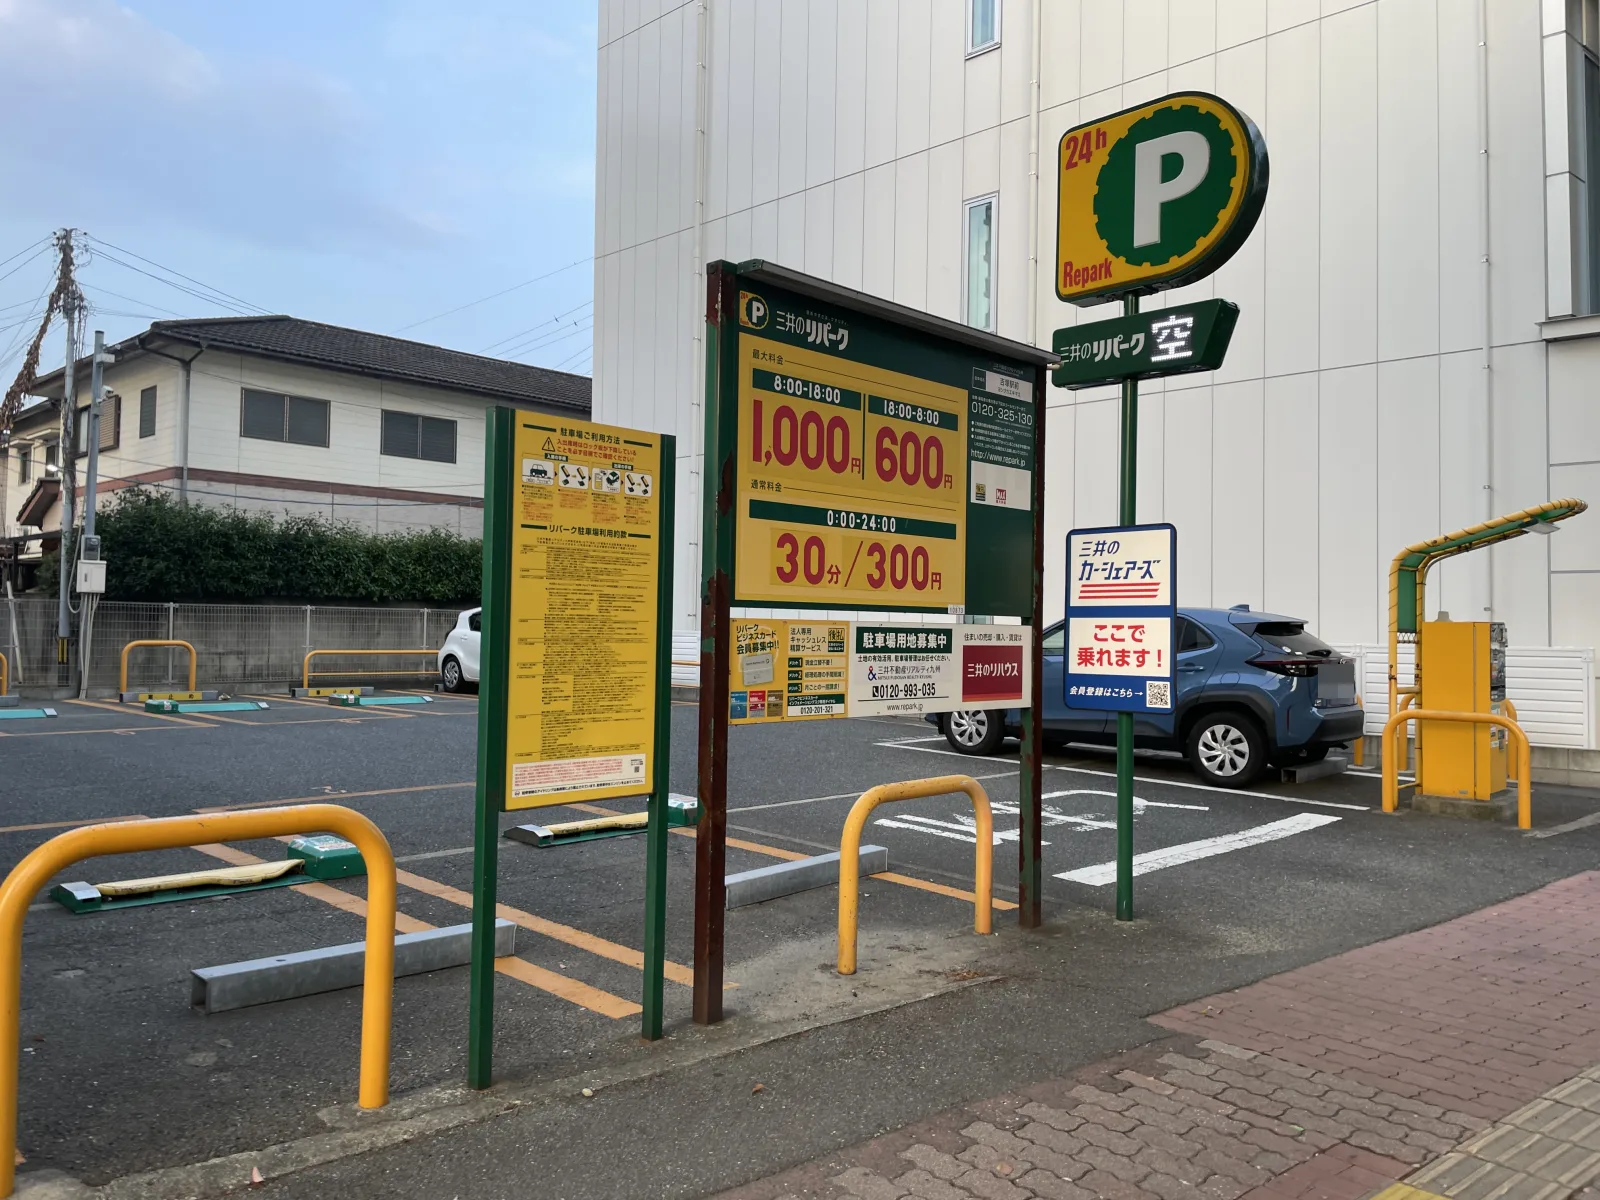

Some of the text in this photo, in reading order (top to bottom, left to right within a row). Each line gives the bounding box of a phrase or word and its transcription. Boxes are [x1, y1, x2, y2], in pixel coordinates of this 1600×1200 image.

[1065, 128, 1107, 170] 24h
[1134, 131, 1210, 248] P
[1063, 258, 1112, 288] Repark
[776, 310, 849, 350] 三井のリパーク
[1151, 315, 1193, 362] 空
[1060, 332, 1145, 363] 三井のリパーク
[752, 349, 784, 365] 最大料金
[773, 375, 841, 404] 8:00-18:00
[883, 400, 939, 425] 18:00-8:00
[560, 428, 620, 444] 駐車場ご利用方法
[875, 426, 953, 489] 600円
[751, 479, 782, 492] 通常料金
[827, 510, 896, 532] 0:00-24:00
[549, 524, 628, 539] リパーク駐車場利用約款
[1079, 540, 1120, 557] 三井の
[1078, 559, 1161, 581] カーシェアーズ
[736, 630, 776, 643] ビジネスカード
[790, 627, 812, 635] 法人専用
[1093, 624, 1145, 643] ここで
[863, 632, 947, 649] 駐車場用地募集中
[1077, 646, 1162, 668] 乗れます!
[878, 665, 941, 675] 三井不動産リアルティ九州
[967, 662, 1018, 677] 三井のリハウス
[880, 683, 936, 698] 0120-993-035
[1069, 685, 1132, 698] 会員登録はこちら
[886, 702, 924, 711] www.repark.jp
